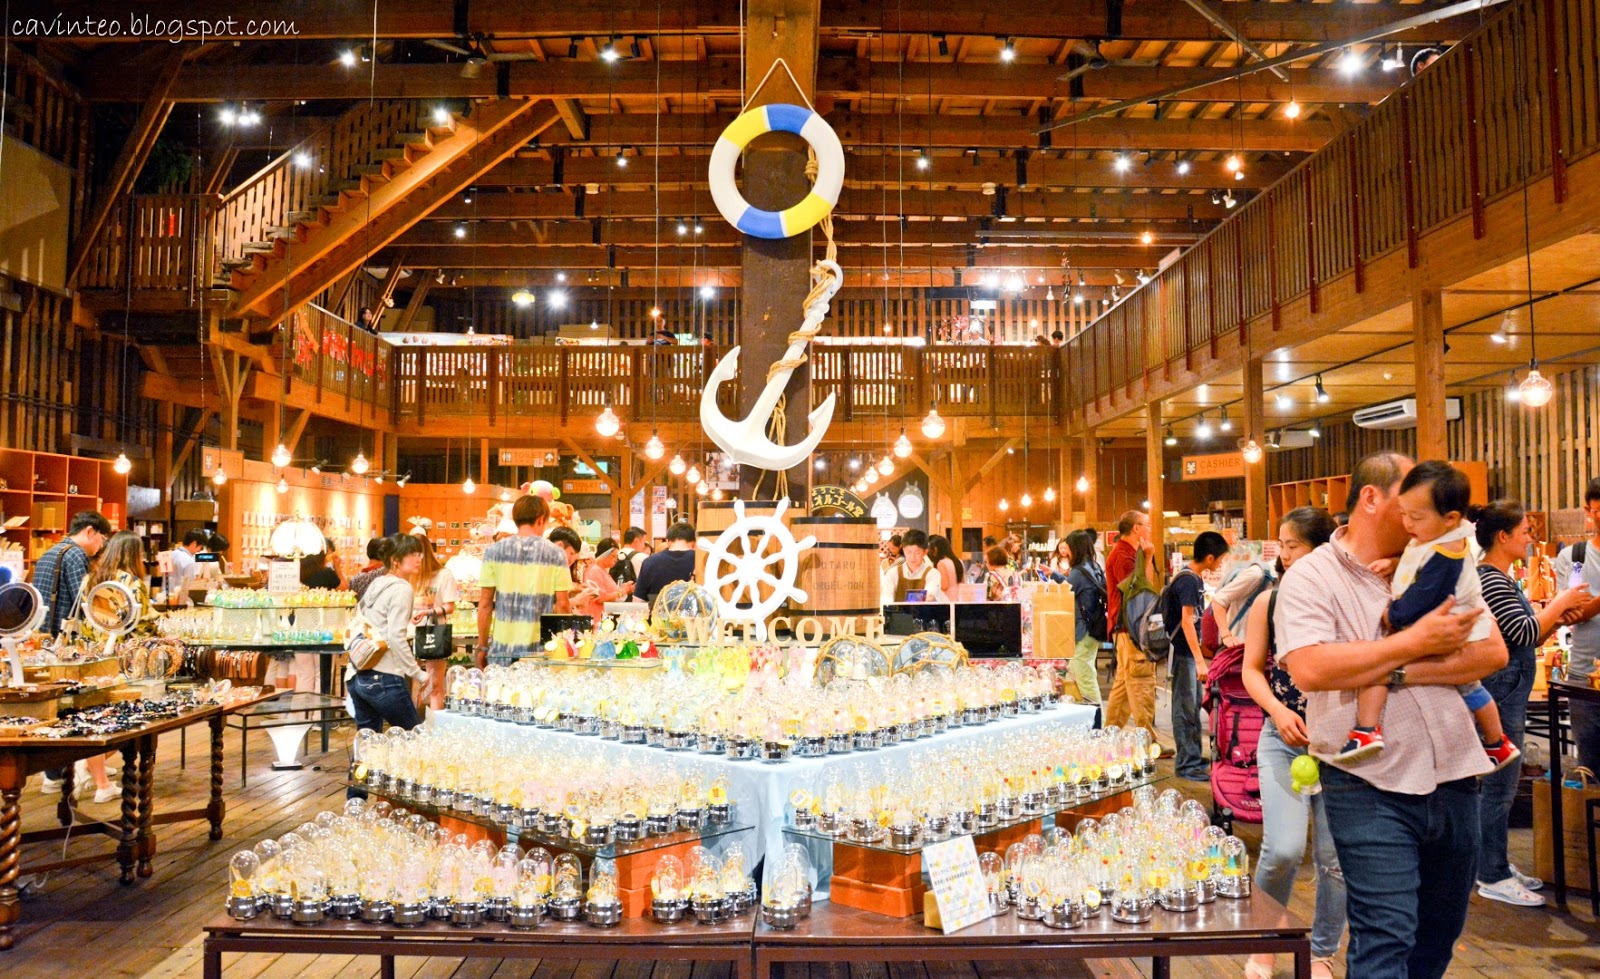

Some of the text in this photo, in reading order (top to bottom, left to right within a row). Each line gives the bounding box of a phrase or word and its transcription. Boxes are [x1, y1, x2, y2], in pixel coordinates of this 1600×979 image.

[1200, 457, 1241, 470] CASHIER
[811, 494, 864, 518] オルゴール堂
[820, 560, 856, 571] OTARU
[684, 615, 886, 647] WELCOME
